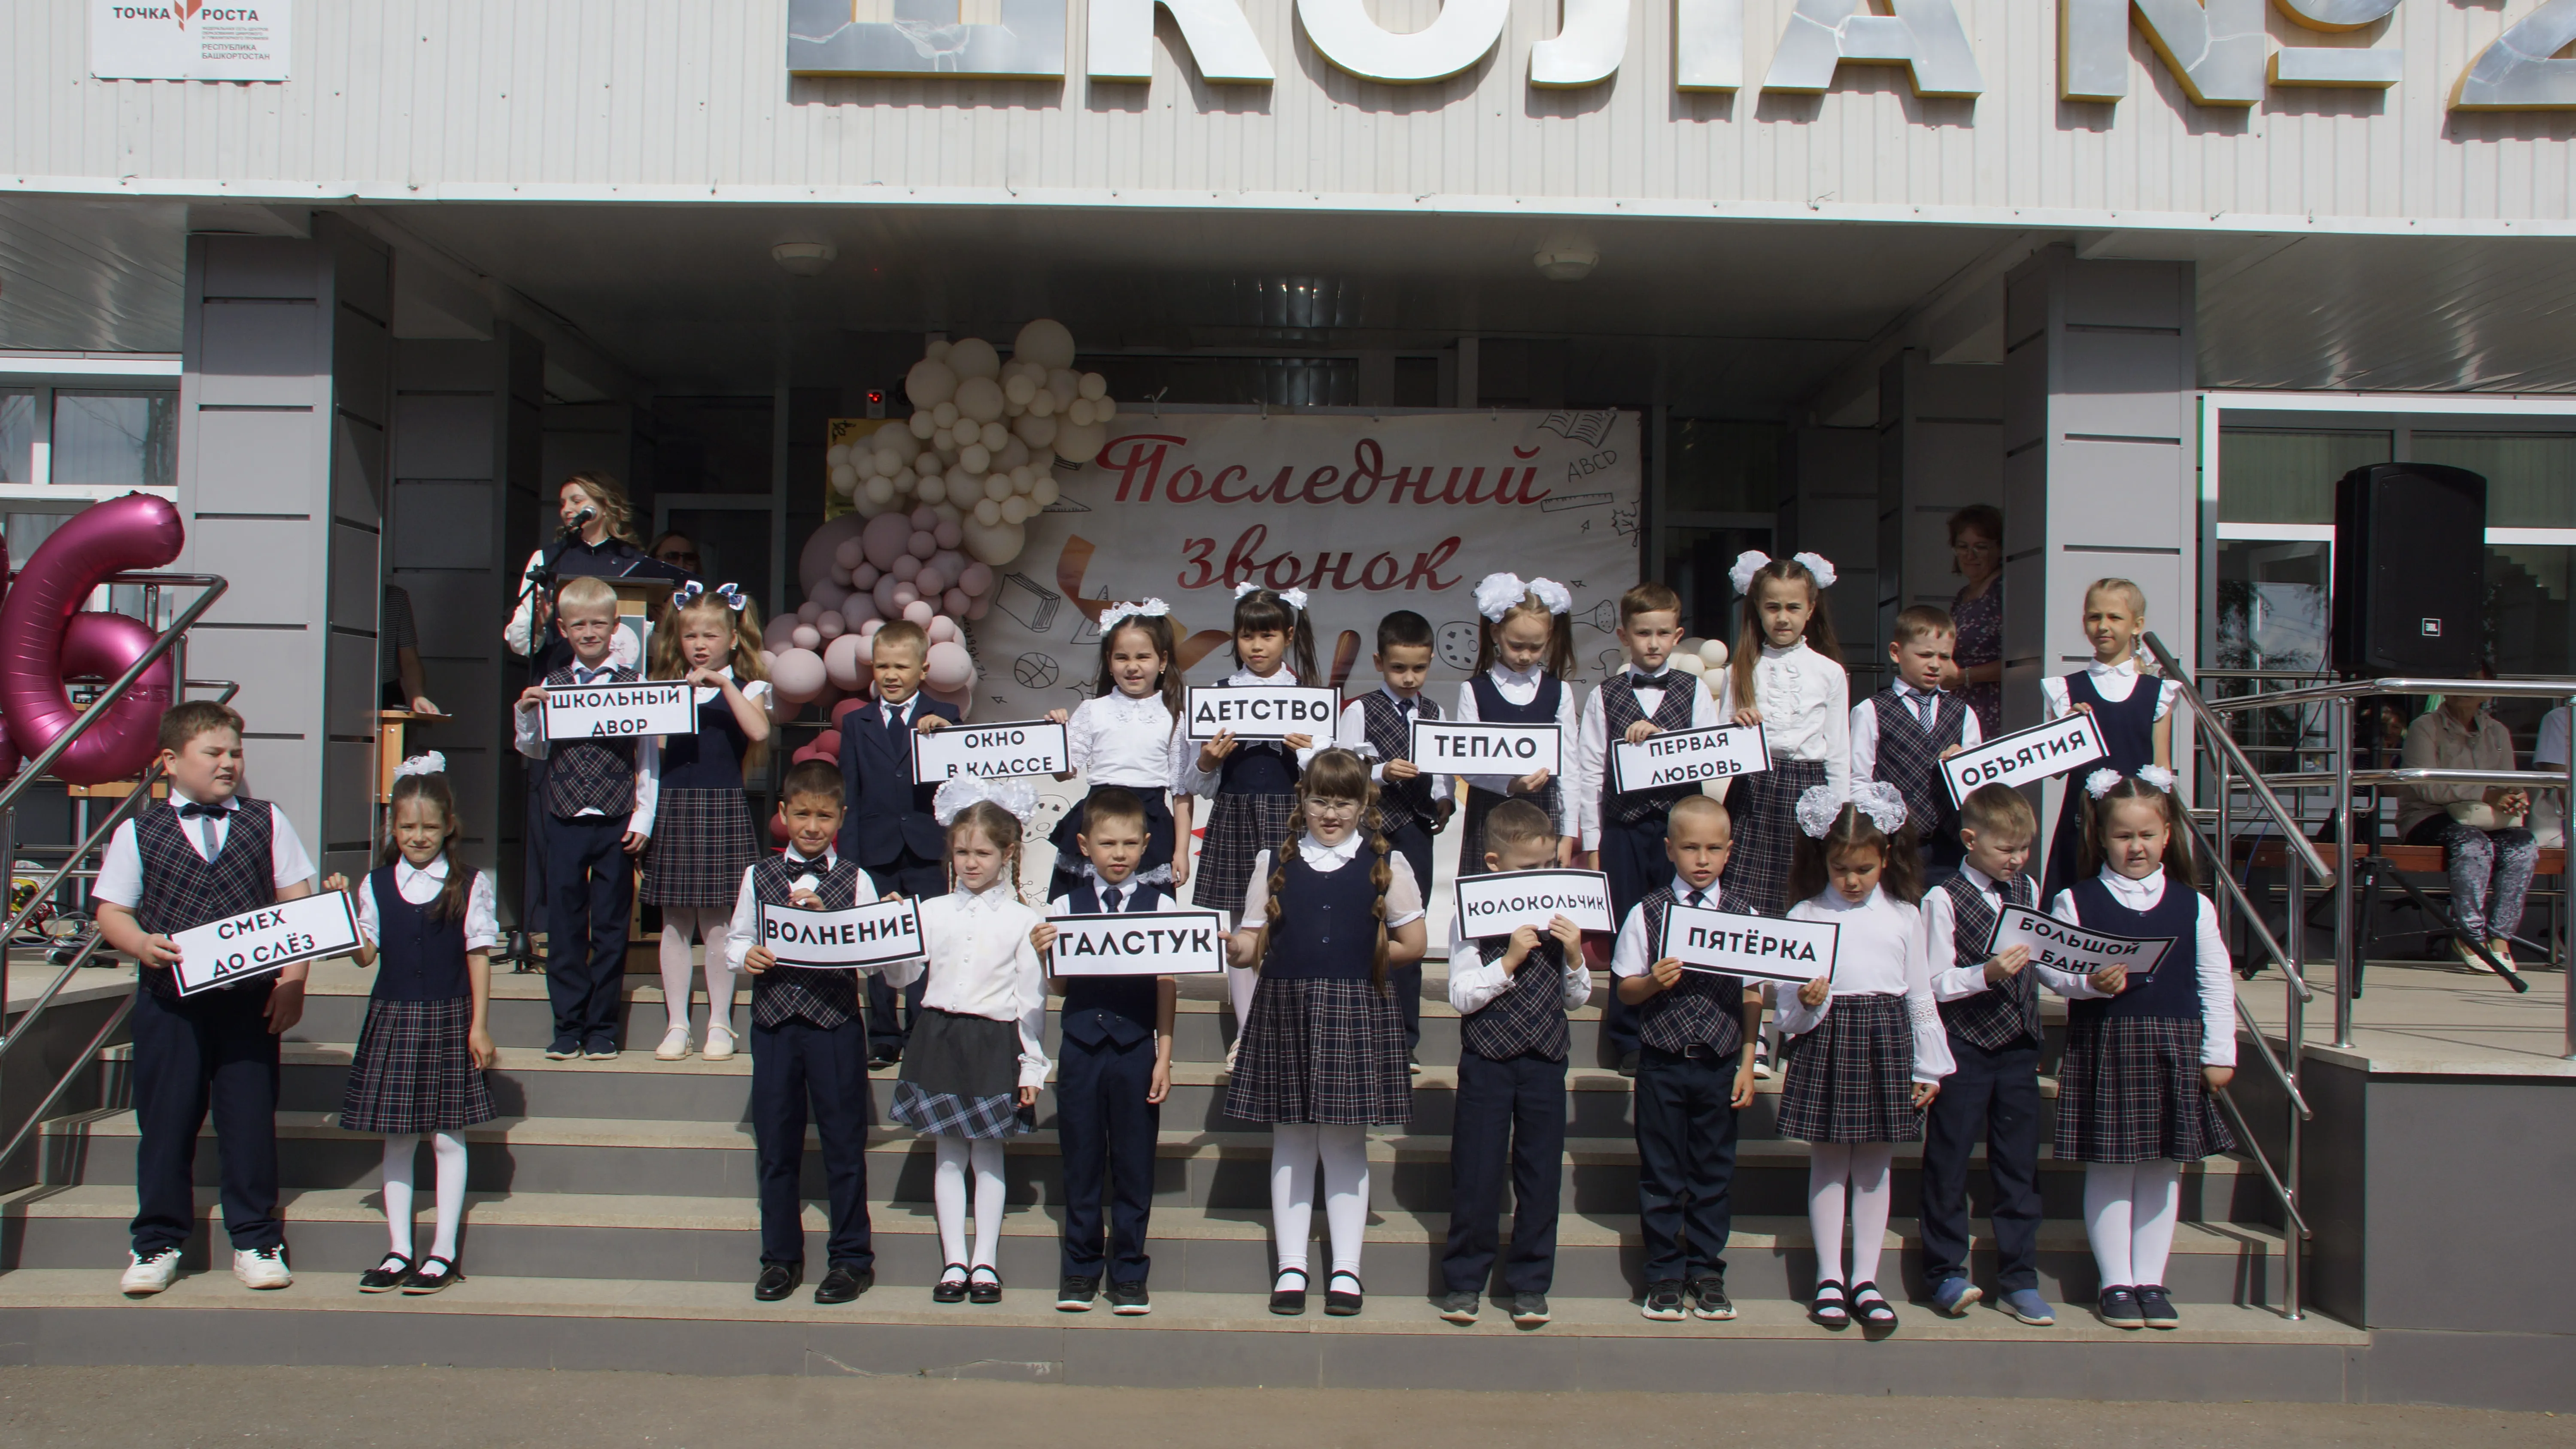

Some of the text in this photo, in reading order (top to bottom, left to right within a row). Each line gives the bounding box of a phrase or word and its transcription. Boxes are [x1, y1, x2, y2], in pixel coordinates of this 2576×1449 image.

[113, 7, 259, 21] ТОЧКА РОСТА
[1095, 434, 1551, 505] Последний
[1568, 450, 1617, 482] ABCD
[552, 685, 680, 709] ШКОЛЬНЫЙ
[1195, 699, 1329, 723] ДЕТСТВО
[592, 718, 648, 737] ДВОР
[965, 731, 1025, 749] ОКНО
[1434, 735, 1536, 759] ТЕПЛО
[1649, 732, 1729, 757] ПЕРВАЯ
[947, 756, 1053, 779] В КЛАССЕ
[1961, 730, 2087, 786] ОБЪЯТИЯ
[1651, 759, 1742, 785] ЛЮБОВЬ
[1467, 894, 1606, 917] КОЛОКОЛЬЧИК
[218, 909, 287, 940] СМЕХ
[766, 913, 916, 945] ВОЛНЕНИЕ
[2018, 917, 2142, 955] БОЛЬШОЙ
[1059, 928, 1212, 956] ГАЛСТУК
[1688, 927, 1817, 962] ПЯТЁРКА
[213, 932, 315, 978] ДО СЛЁЗ
[2039, 949, 2101, 973] БАНТ
